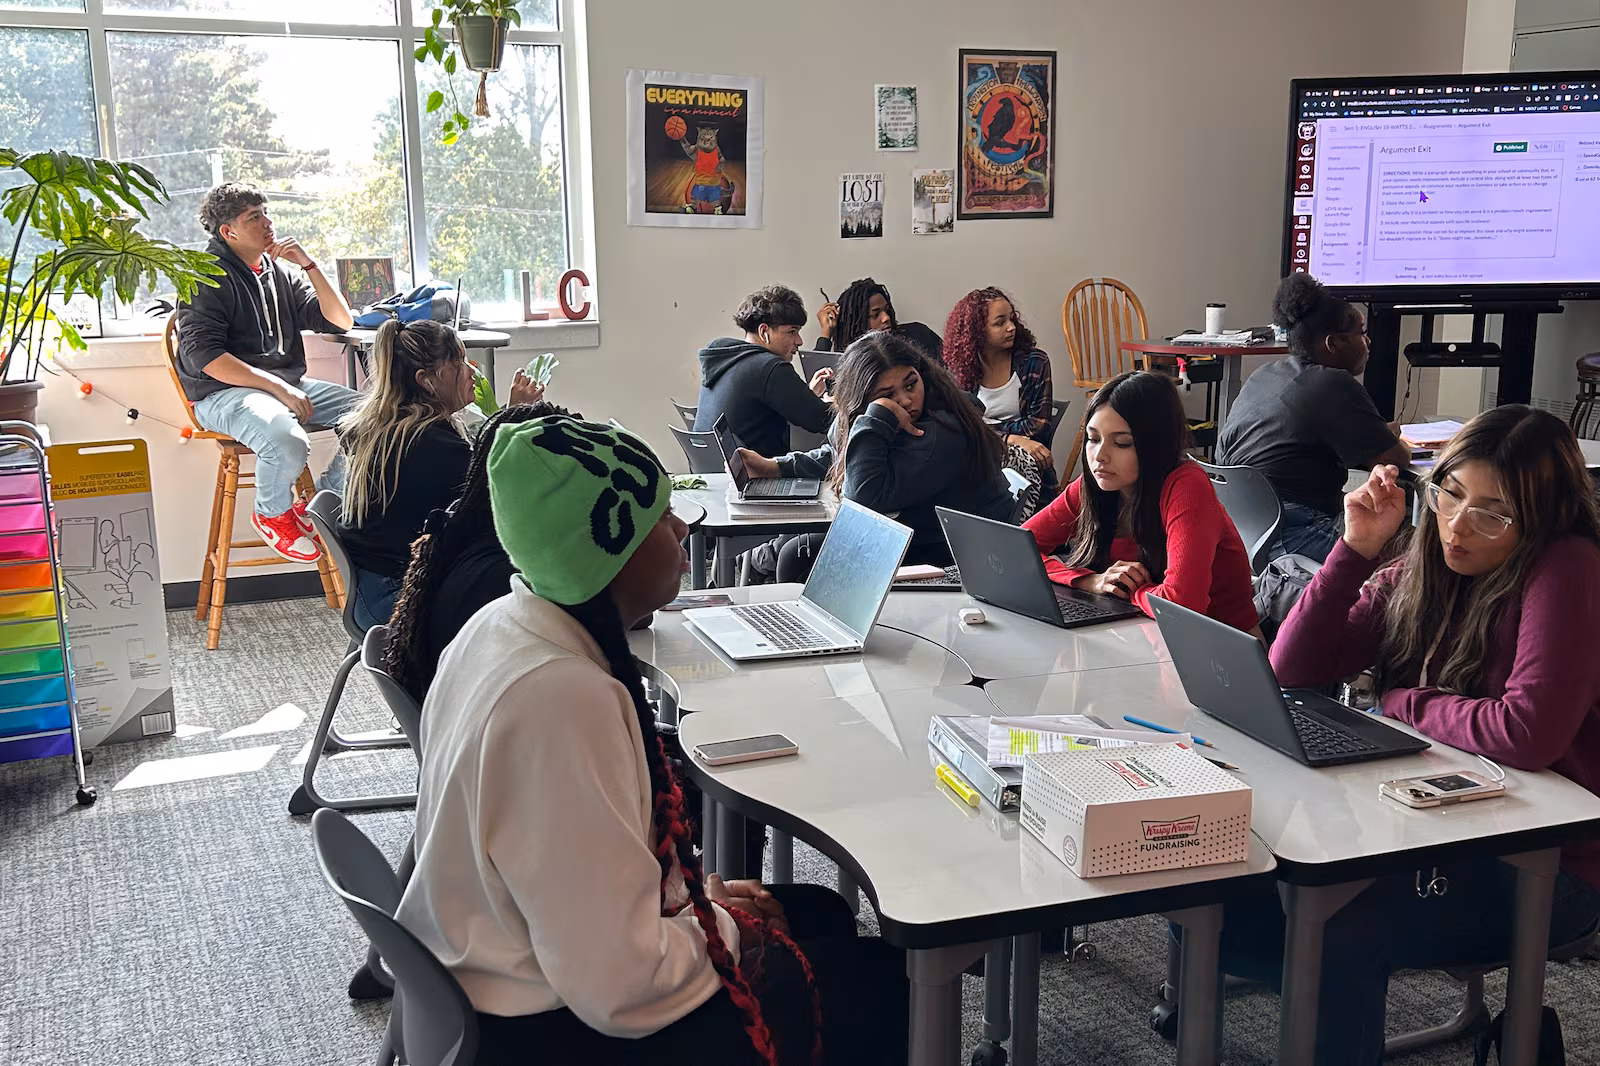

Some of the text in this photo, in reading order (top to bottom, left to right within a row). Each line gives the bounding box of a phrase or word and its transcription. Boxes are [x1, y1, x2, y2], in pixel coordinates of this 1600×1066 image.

[646, 87, 743, 107] EVERYTHING
[967, 79, 999, 111] IRVINGTON
[1016, 77, 1047, 122] HALLOWEEN
[1380, 145, 1432, 155] Argument Exit
[843, 179, 882, 203] LOST
[522, 269, 591, 321] L C
[72, 480, 96, 488] MOBILES
[96, 476, 146, 486] SUPERCOLLANTES
[80, 472, 116, 481] SUPERSTICKY
[98, 483, 146, 492] REPOSICIONABLES
[1146, 820, 1196, 836] Krispy Kreme
[1140, 838, 1200, 852] FUNDRAISING
